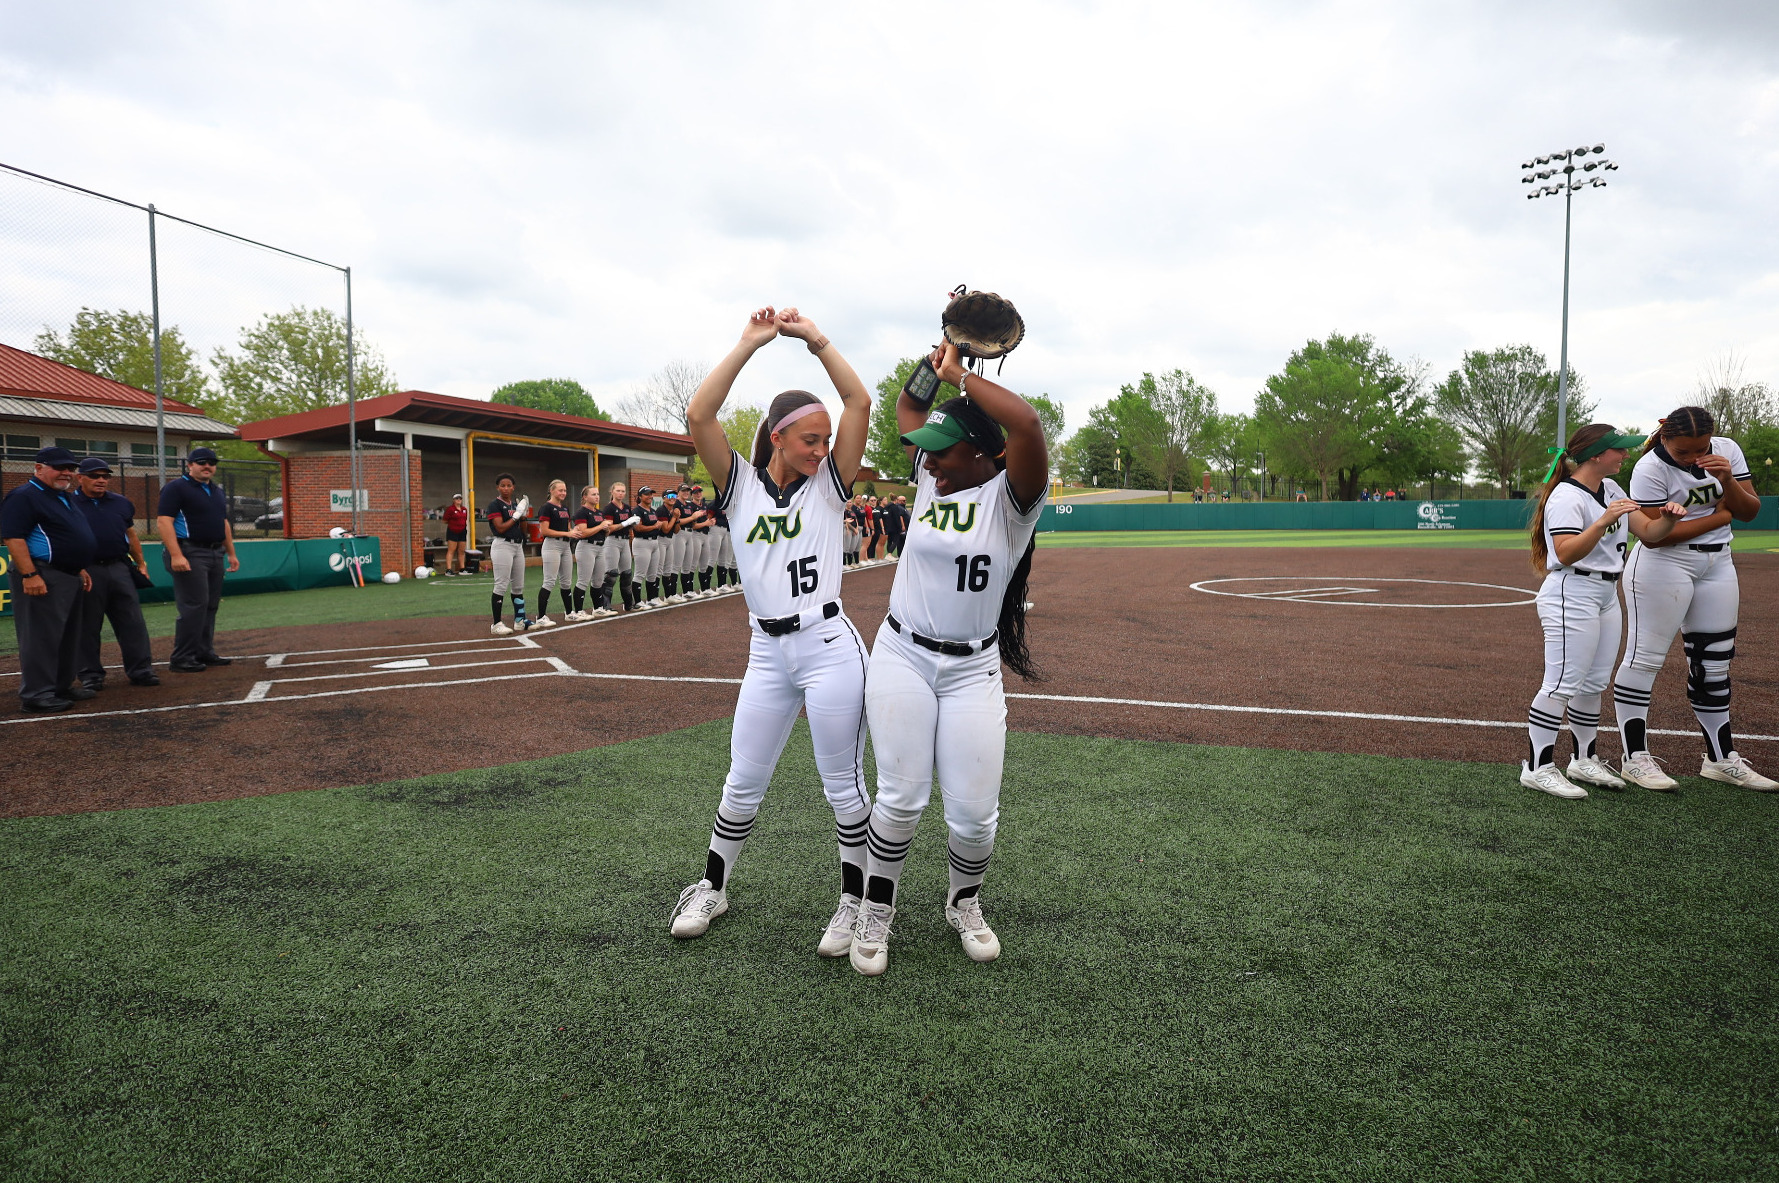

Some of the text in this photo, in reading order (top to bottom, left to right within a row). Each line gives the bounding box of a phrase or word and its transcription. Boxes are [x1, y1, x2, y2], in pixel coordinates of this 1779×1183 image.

[745, 508, 802, 544] ATU
[918, 501, 977, 533] ATU
[1055, 504, 1073, 514] 190
[786, 554, 819, 598] 15
[954, 554, 992, 593] 16
